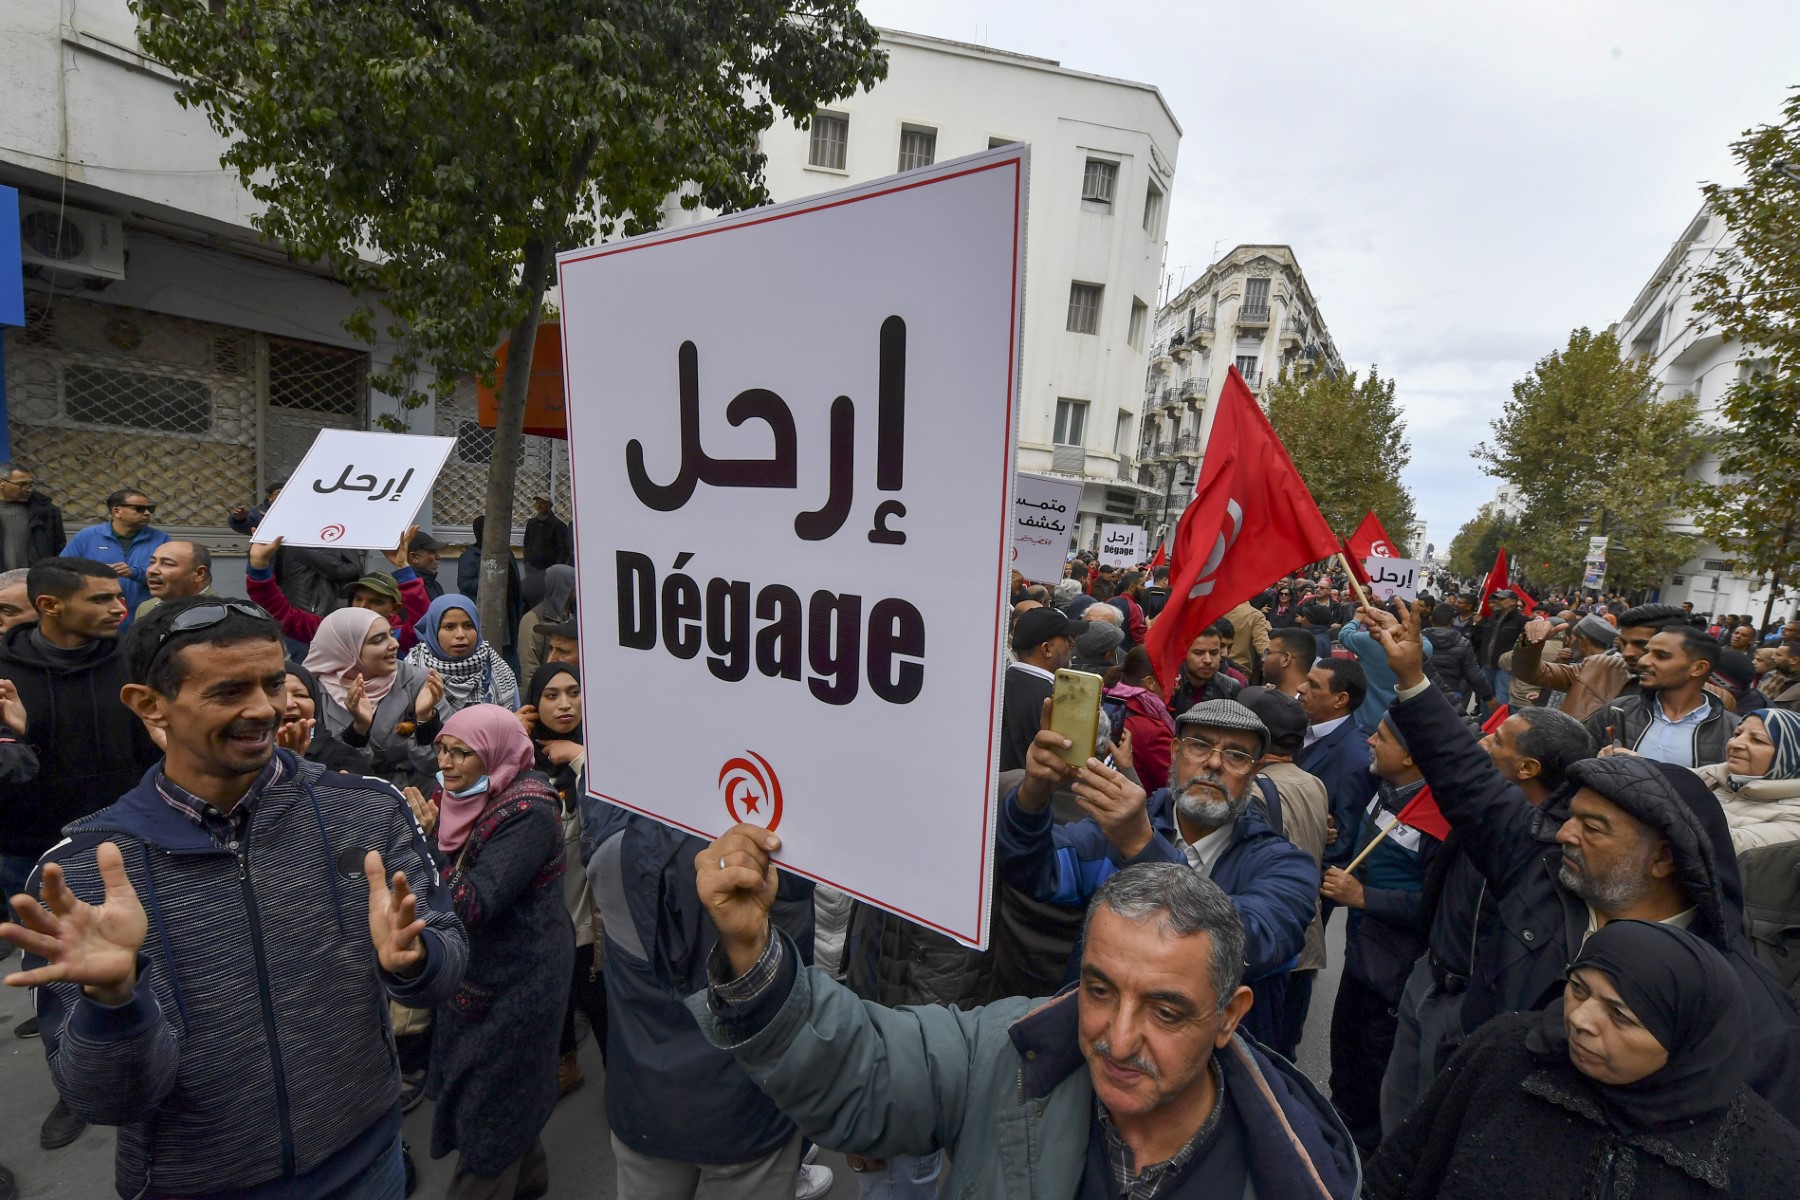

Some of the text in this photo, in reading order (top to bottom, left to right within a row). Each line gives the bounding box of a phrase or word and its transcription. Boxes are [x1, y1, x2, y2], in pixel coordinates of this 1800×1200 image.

[626, 315, 907, 545] إرحل
[313, 464, 415, 502] إرحل
[1018, 515, 1066, 536] بكشف
[1107, 531, 1134, 546] إرحل
[1104, 545, 1134, 556] Dégage
[1370, 566, 1414, 589] إرحل
[616, 550, 925, 706] Dégage
